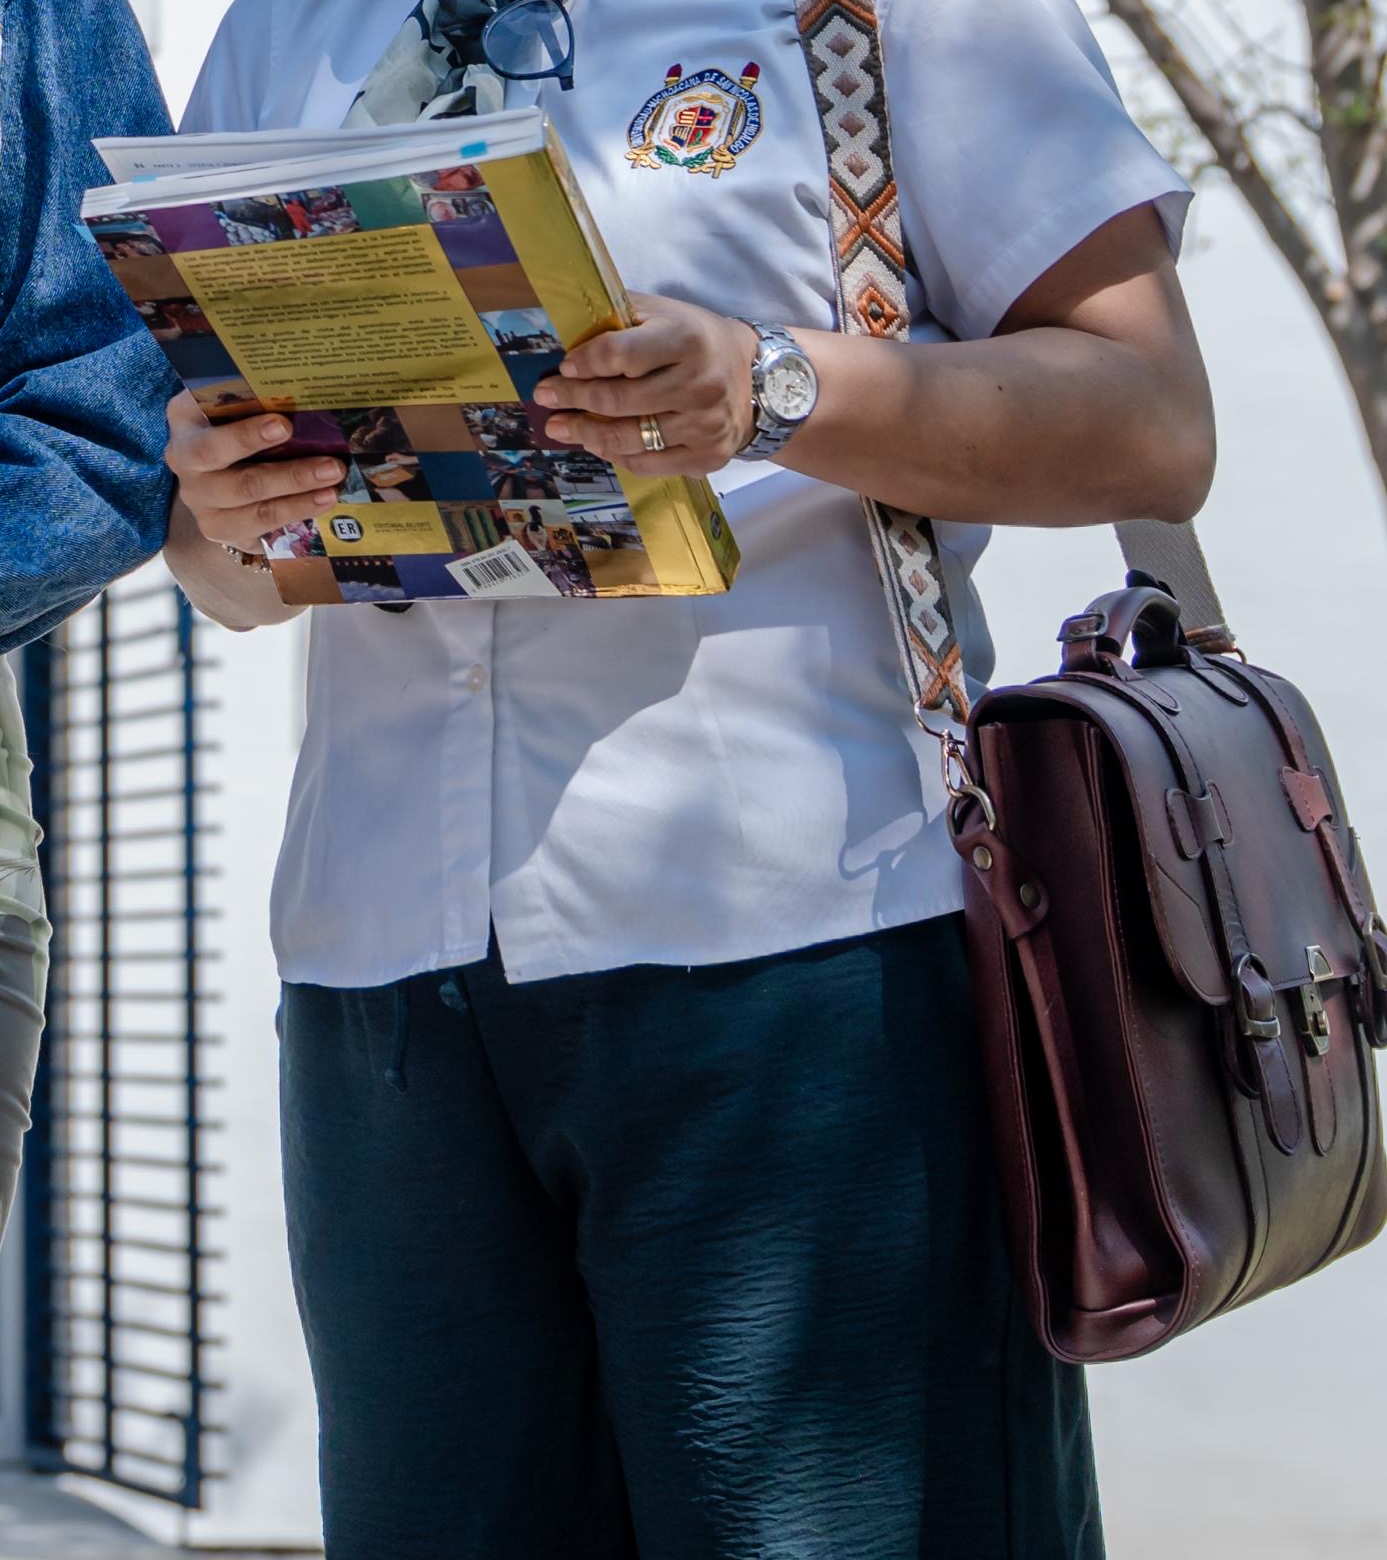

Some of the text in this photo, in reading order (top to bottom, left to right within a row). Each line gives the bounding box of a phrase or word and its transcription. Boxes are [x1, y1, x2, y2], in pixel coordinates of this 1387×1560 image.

[704, 72, 719, 82] DE
[717, 77, 734, 90] SAN
[339, 523, 358, 535] ER
